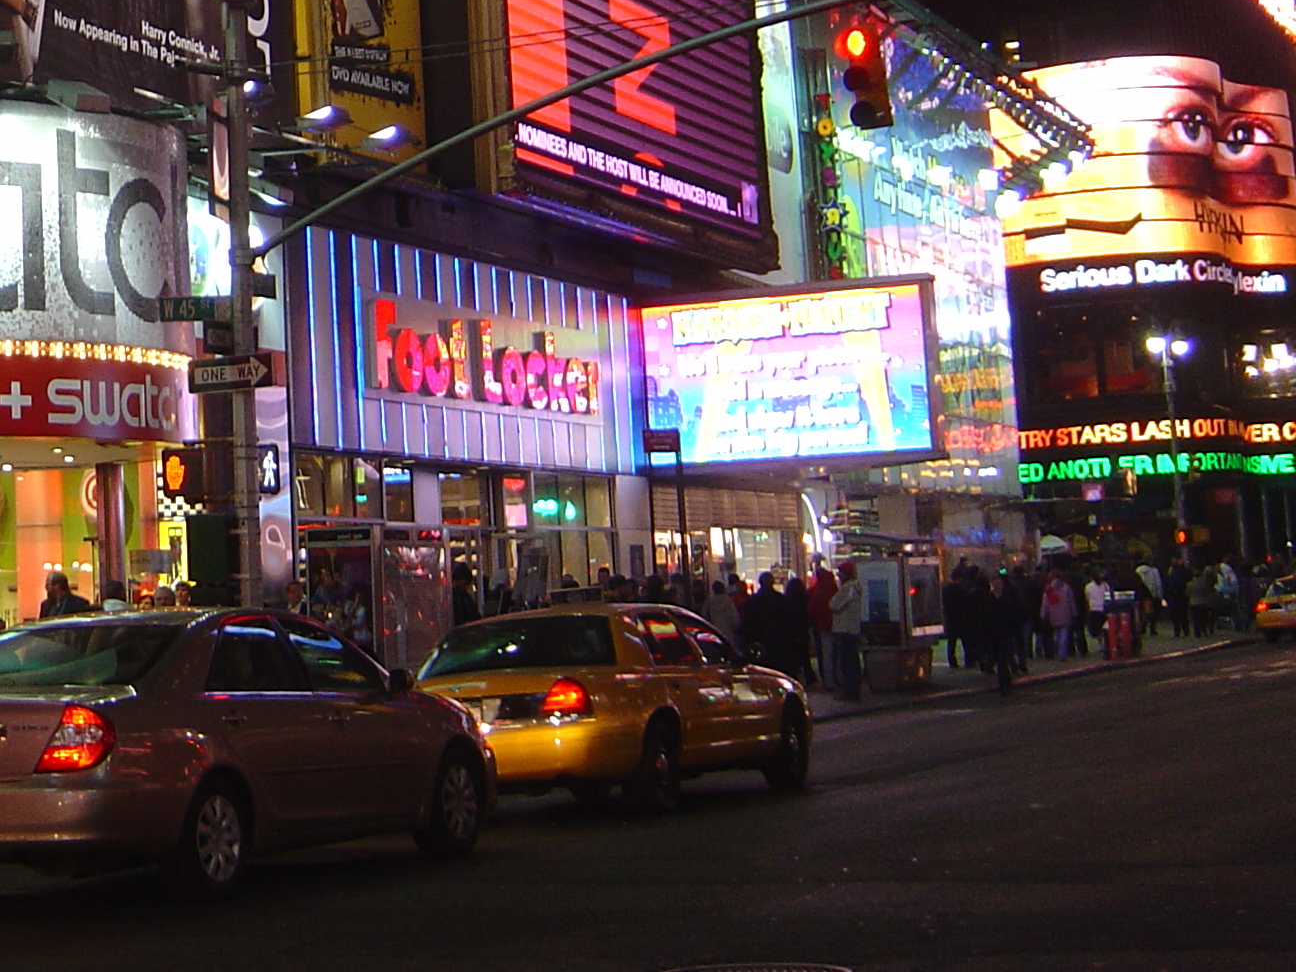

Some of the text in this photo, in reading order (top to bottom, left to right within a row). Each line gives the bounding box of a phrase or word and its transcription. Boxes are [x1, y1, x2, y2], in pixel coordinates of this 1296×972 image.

[54, 9, 77, 31] Now
[78, 18, 128, 53] Appearing
[129, 35, 140, 54] in
[141, 39, 159, 59] The
[141, 20, 221, 62] Harry Connick, Jr.
[331, 65, 410, 95] DVD AVAILABLE NOW
[518, 122, 568, 159] NOMINEES
[568, 141, 587, 166] AND
[587, 148, 606, 170] THE
[605, 155, 629, 179] HOST
[629, 163, 649, 186] WILL
[649, 170, 661, 190] BE
[660, 174, 706, 206] ANNOUNCED
[1040, 263, 1133, 293] Serious
[1134, 258, 1192, 284] Dark
[164, 299, 175, 319] W
[179, 298, 196, 318] 45
[201, 364, 261, 382] ONE WAY
[369, 298, 602, 416] Foot Locker
[48, 373, 179, 431] swatc
[1018, 429, 1054, 450] TRY
[1056, 424, 1128, 447] STARS
[1131, 419, 1192, 442] LASH
[1193, 418, 1227, 438] OUT
[1018, 461, 1044, 484] ED
